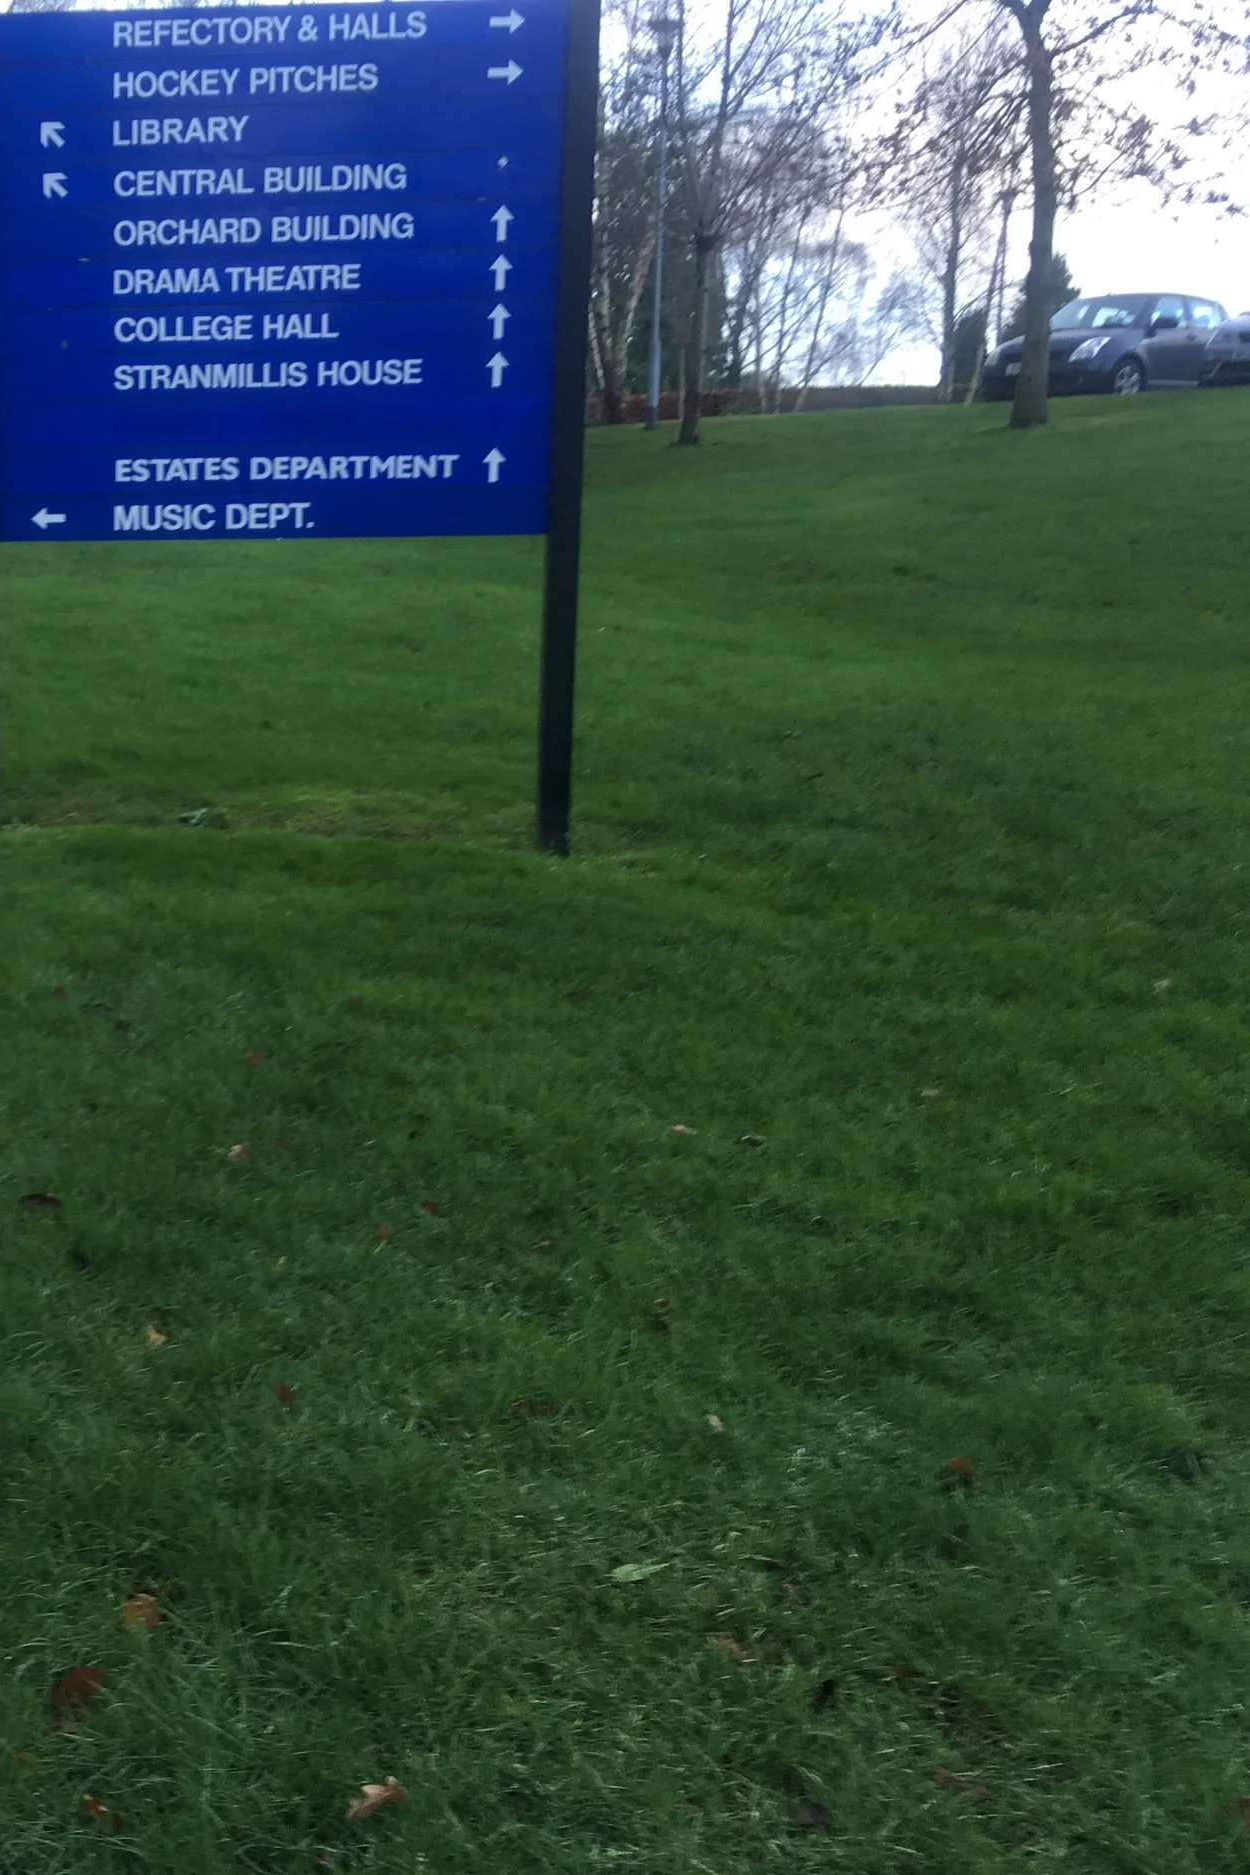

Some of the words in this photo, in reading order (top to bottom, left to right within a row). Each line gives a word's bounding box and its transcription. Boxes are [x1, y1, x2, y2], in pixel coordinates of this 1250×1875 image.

[113, 17, 289, 47] REFECTORY
[329, 11, 427, 41] HALLS
[113, 69, 239, 98] HOCKEY
[250, 64, 379, 94] PITCHES
[113, 116, 249, 146] LIBRARY
[114, 169, 253, 197] CENTRAL
[264, 164, 408, 193] BUILDING
[114, 218, 261, 245] ORCHARD
[271, 213, 414, 242] BUILDING
[113, 268, 220, 295] DRAMA
[226, 264, 361, 292] THEATRE
[114, 316, 252, 343] COLLEGE
[263, 313, 339, 340] HALL
[114, 362, 307, 390] STRANMILLIS
[317, 359, 423, 387] HOUSE
[115, 457, 239, 482] ESTATES
[250, 454, 460, 481] DEPARTMENT
[113, 505, 215, 531] MUSIC
[226, 503, 315, 530] DEPT.
